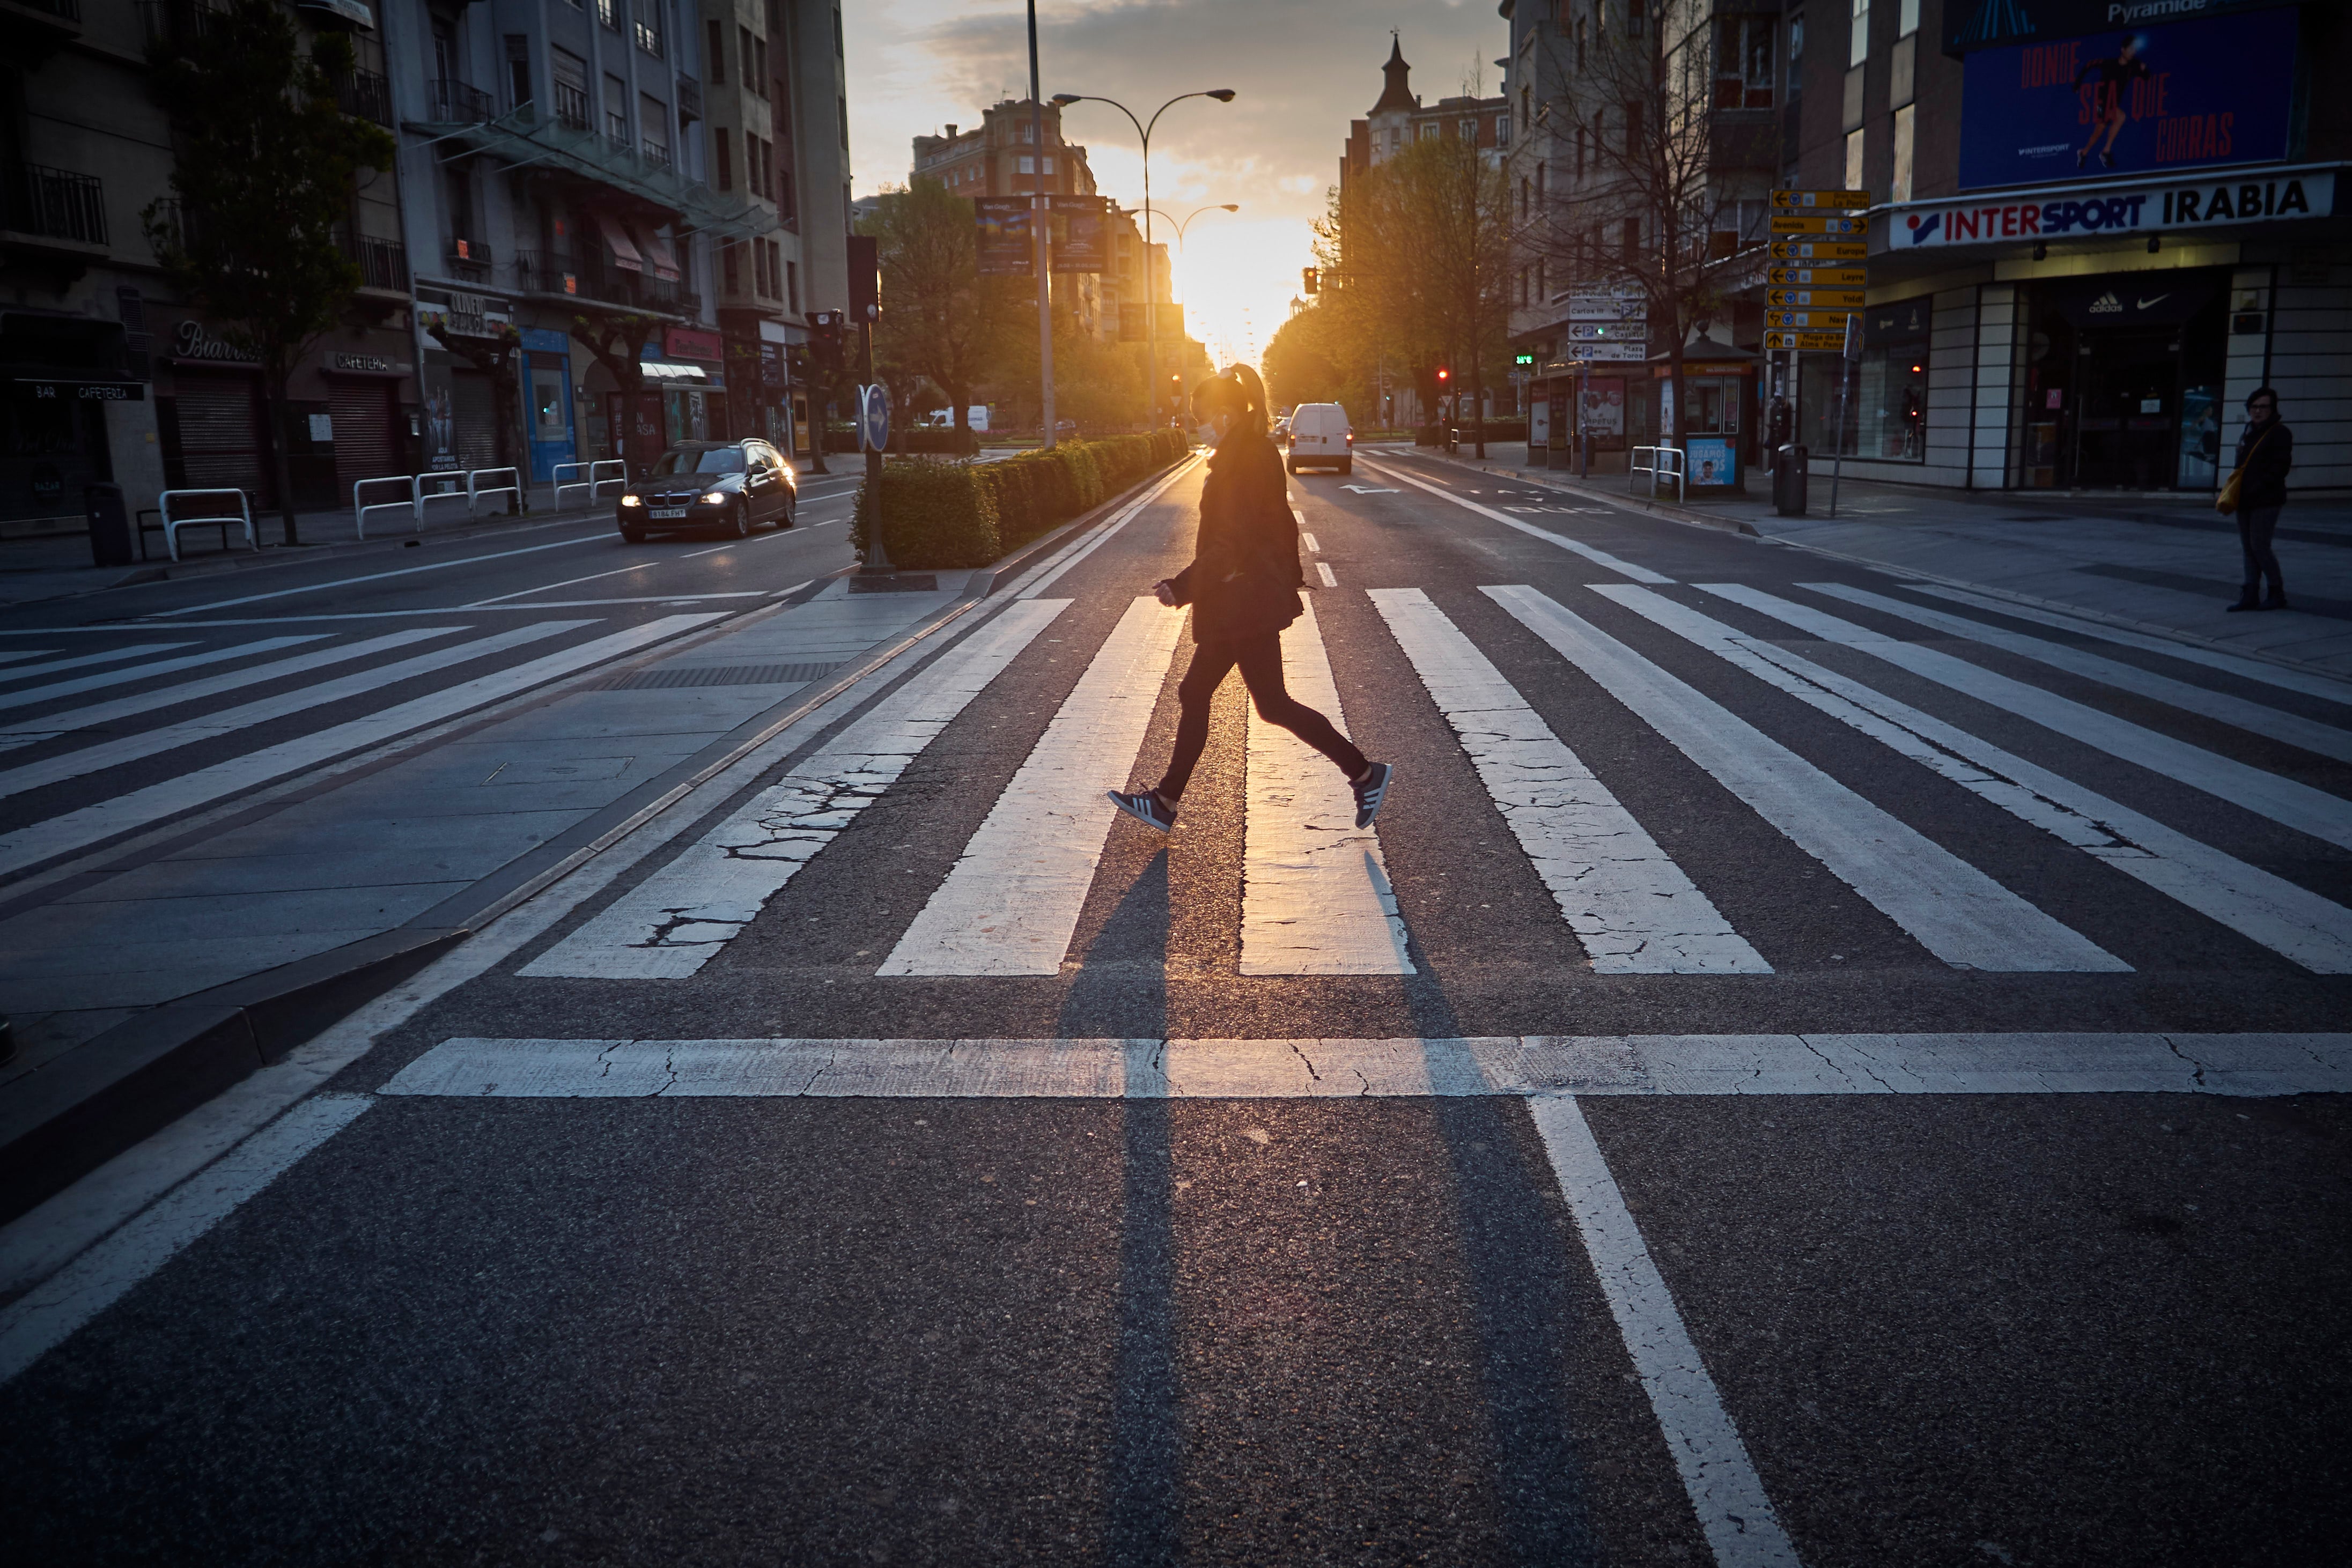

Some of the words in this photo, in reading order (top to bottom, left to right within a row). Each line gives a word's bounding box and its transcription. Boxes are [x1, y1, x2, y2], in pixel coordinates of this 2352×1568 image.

[2021, 41, 2082, 90] DONDE
[2078, 79, 2118, 124] SEA
[2131, 72, 2171, 122] QUE
[2156, 111, 2235, 163] CORRAS
[2025, 142, 2071, 155] INTERSPORT
[1944, 195, 2145, 241] INTERSPORT
[2163, 181, 2309, 224] IRABIA
[1773, 221, 1804, 229] Avenida
[1837, 247, 1865, 256] Europa
[2089, 304, 2122, 313] adidas
[35, 385, 56, 399] BAR
